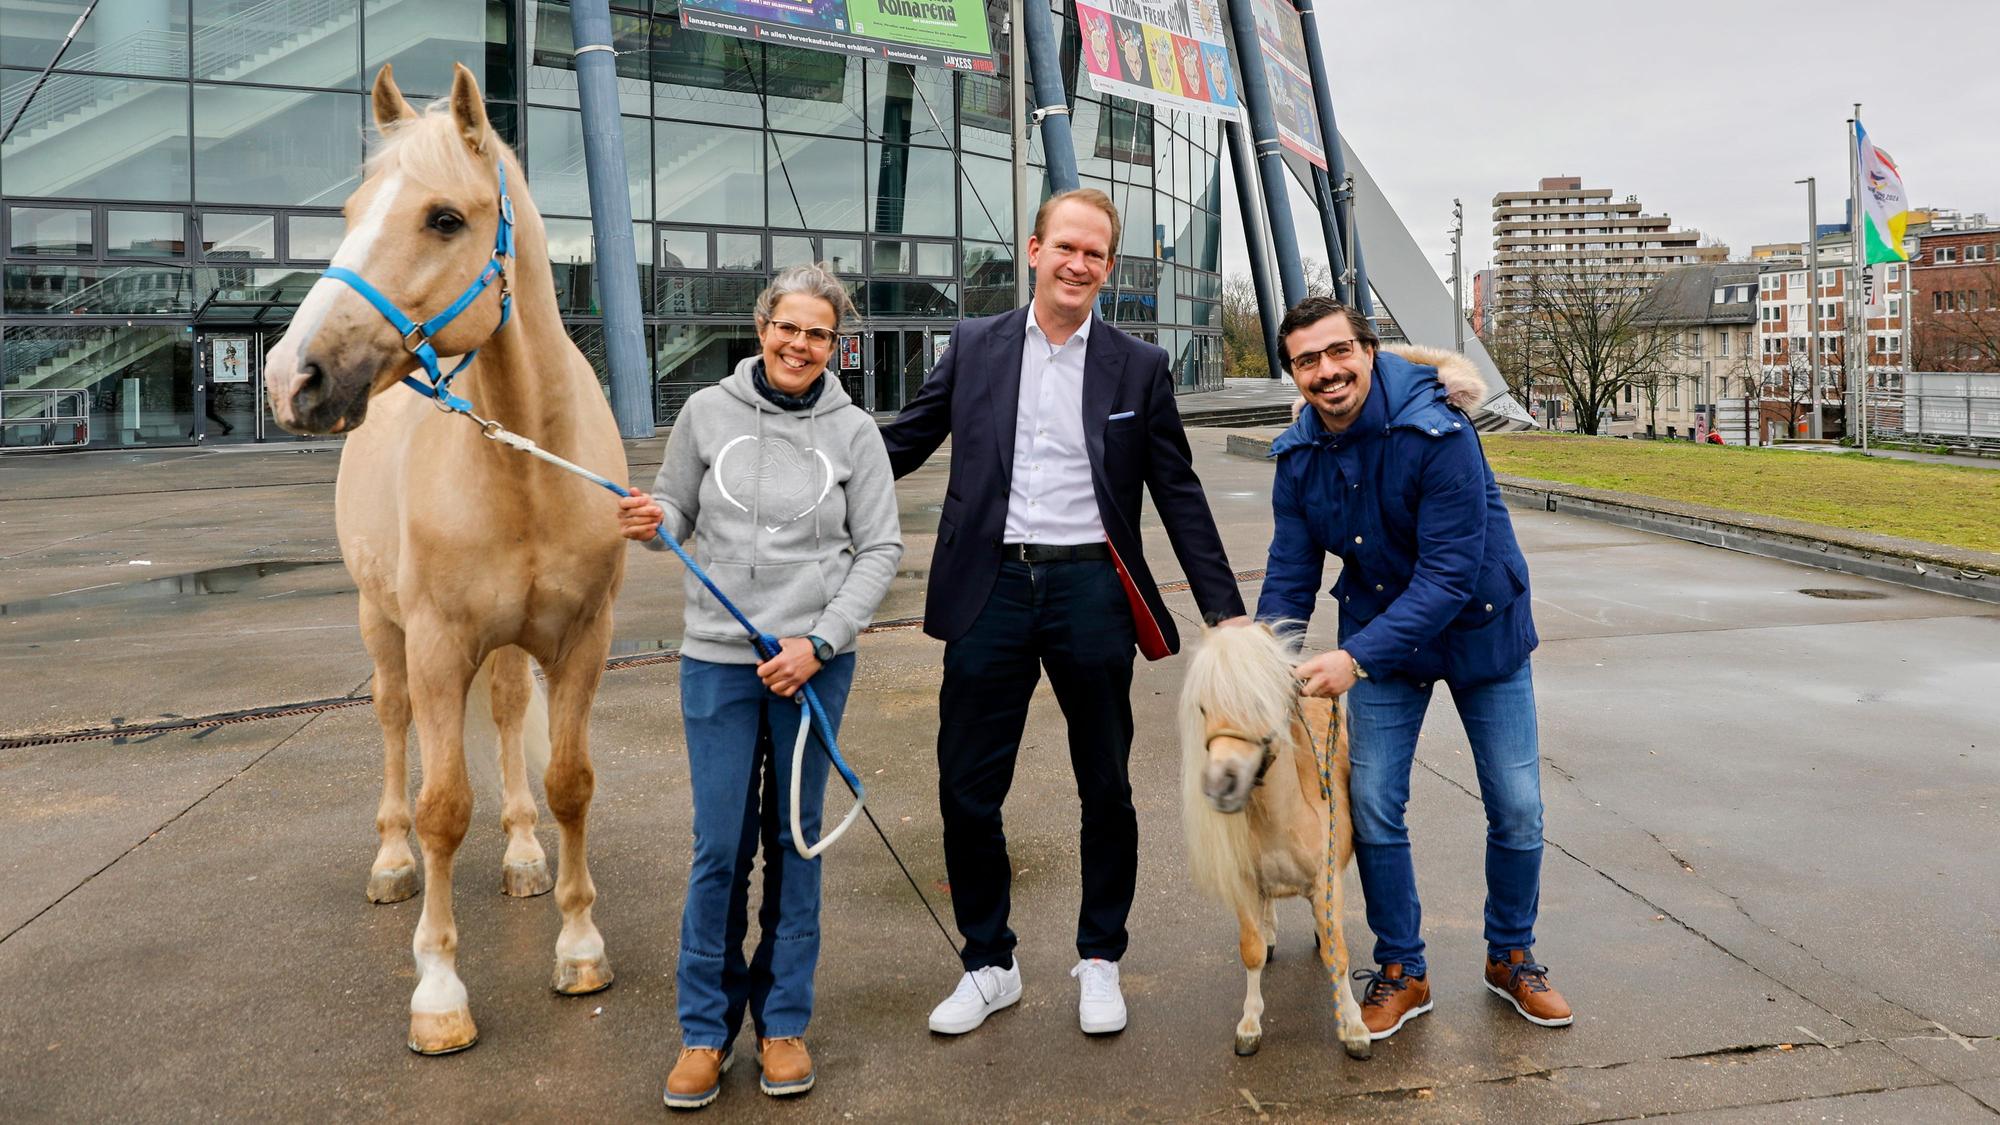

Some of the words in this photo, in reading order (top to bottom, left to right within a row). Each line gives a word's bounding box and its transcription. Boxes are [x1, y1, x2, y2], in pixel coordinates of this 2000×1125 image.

[688, 16, 748, 32] lanxess-arena.de
[1143, 6, 1169, 30] FREAK
[760, 28, 770, 36] An
[770, 29, 787, 39] allen
[787, 31, 846, 49] Vorverkaufsstellen
[943, 55, 973, 70] LANXESS
[972, 58, 994, 72] arena
